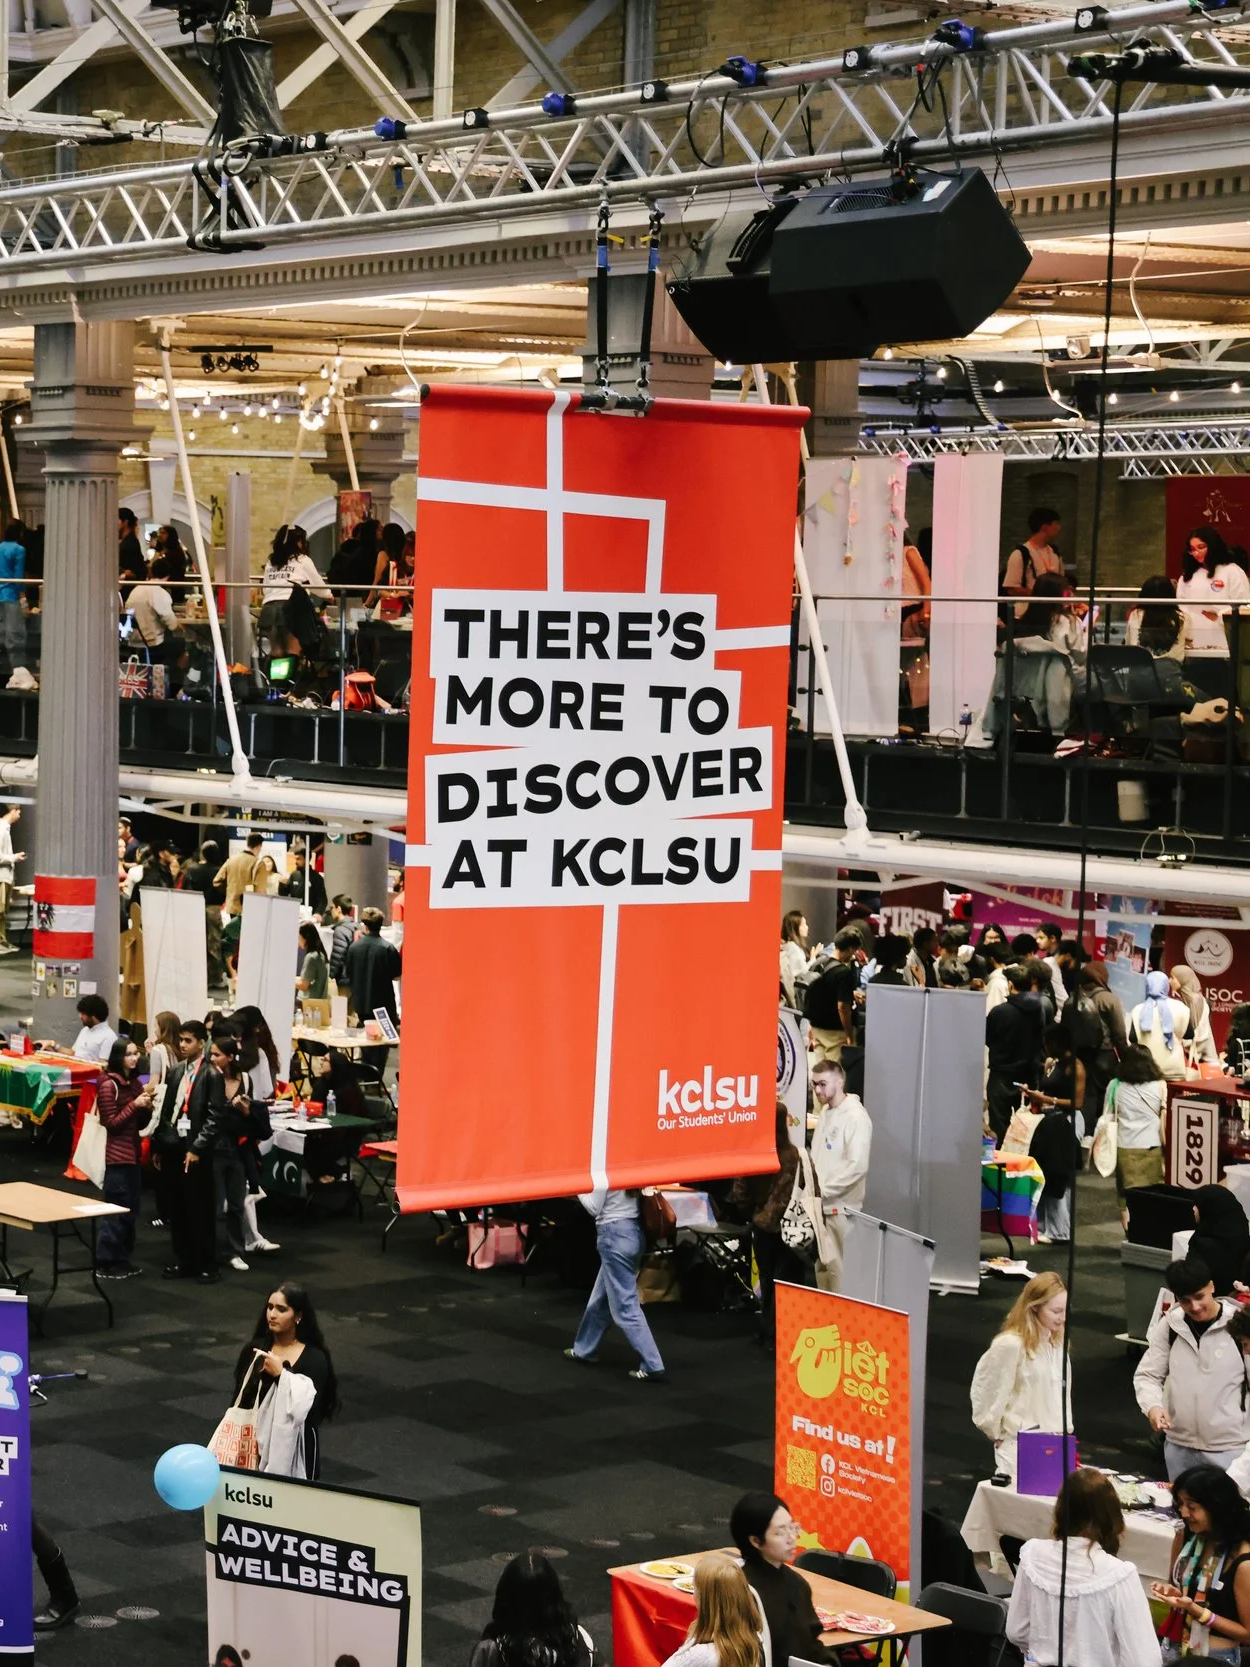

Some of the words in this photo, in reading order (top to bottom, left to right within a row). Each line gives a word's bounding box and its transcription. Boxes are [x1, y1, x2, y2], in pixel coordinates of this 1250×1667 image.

[443, 608, 706, 661] THERE'S
[446, 675, 624, 732] MORE
[649, 686, 729, 736] TO
[437, 746, 763, 824] DISCOVER
[442, 839, 527, 889] AT
[551, 837, 741, 887] KCLSU
[879, 906, 943, 937] FIRST
[1205, 987, 1243, 1003] ISOC
[657, 1065, 758, 1116] kclsu
[657, 1117, 677, 1131] Our
[678, 1111, 726, 1128] Students'
[728, 1109, 757, 1124] Union
[1186, 1114, 1204, 1185] 1829
[792, 1414, 834, 1442] Find
[836, 1430, 862, 1449] us
[860, 1402, 887, 1418] KCL
[224, 1482, 273, 1509] kclsu
[221, 1523, 338, 1566] ADVICE
[347, 1550, 370, 1574] &
[217, 1552, 404, 1602] WELLBEING
